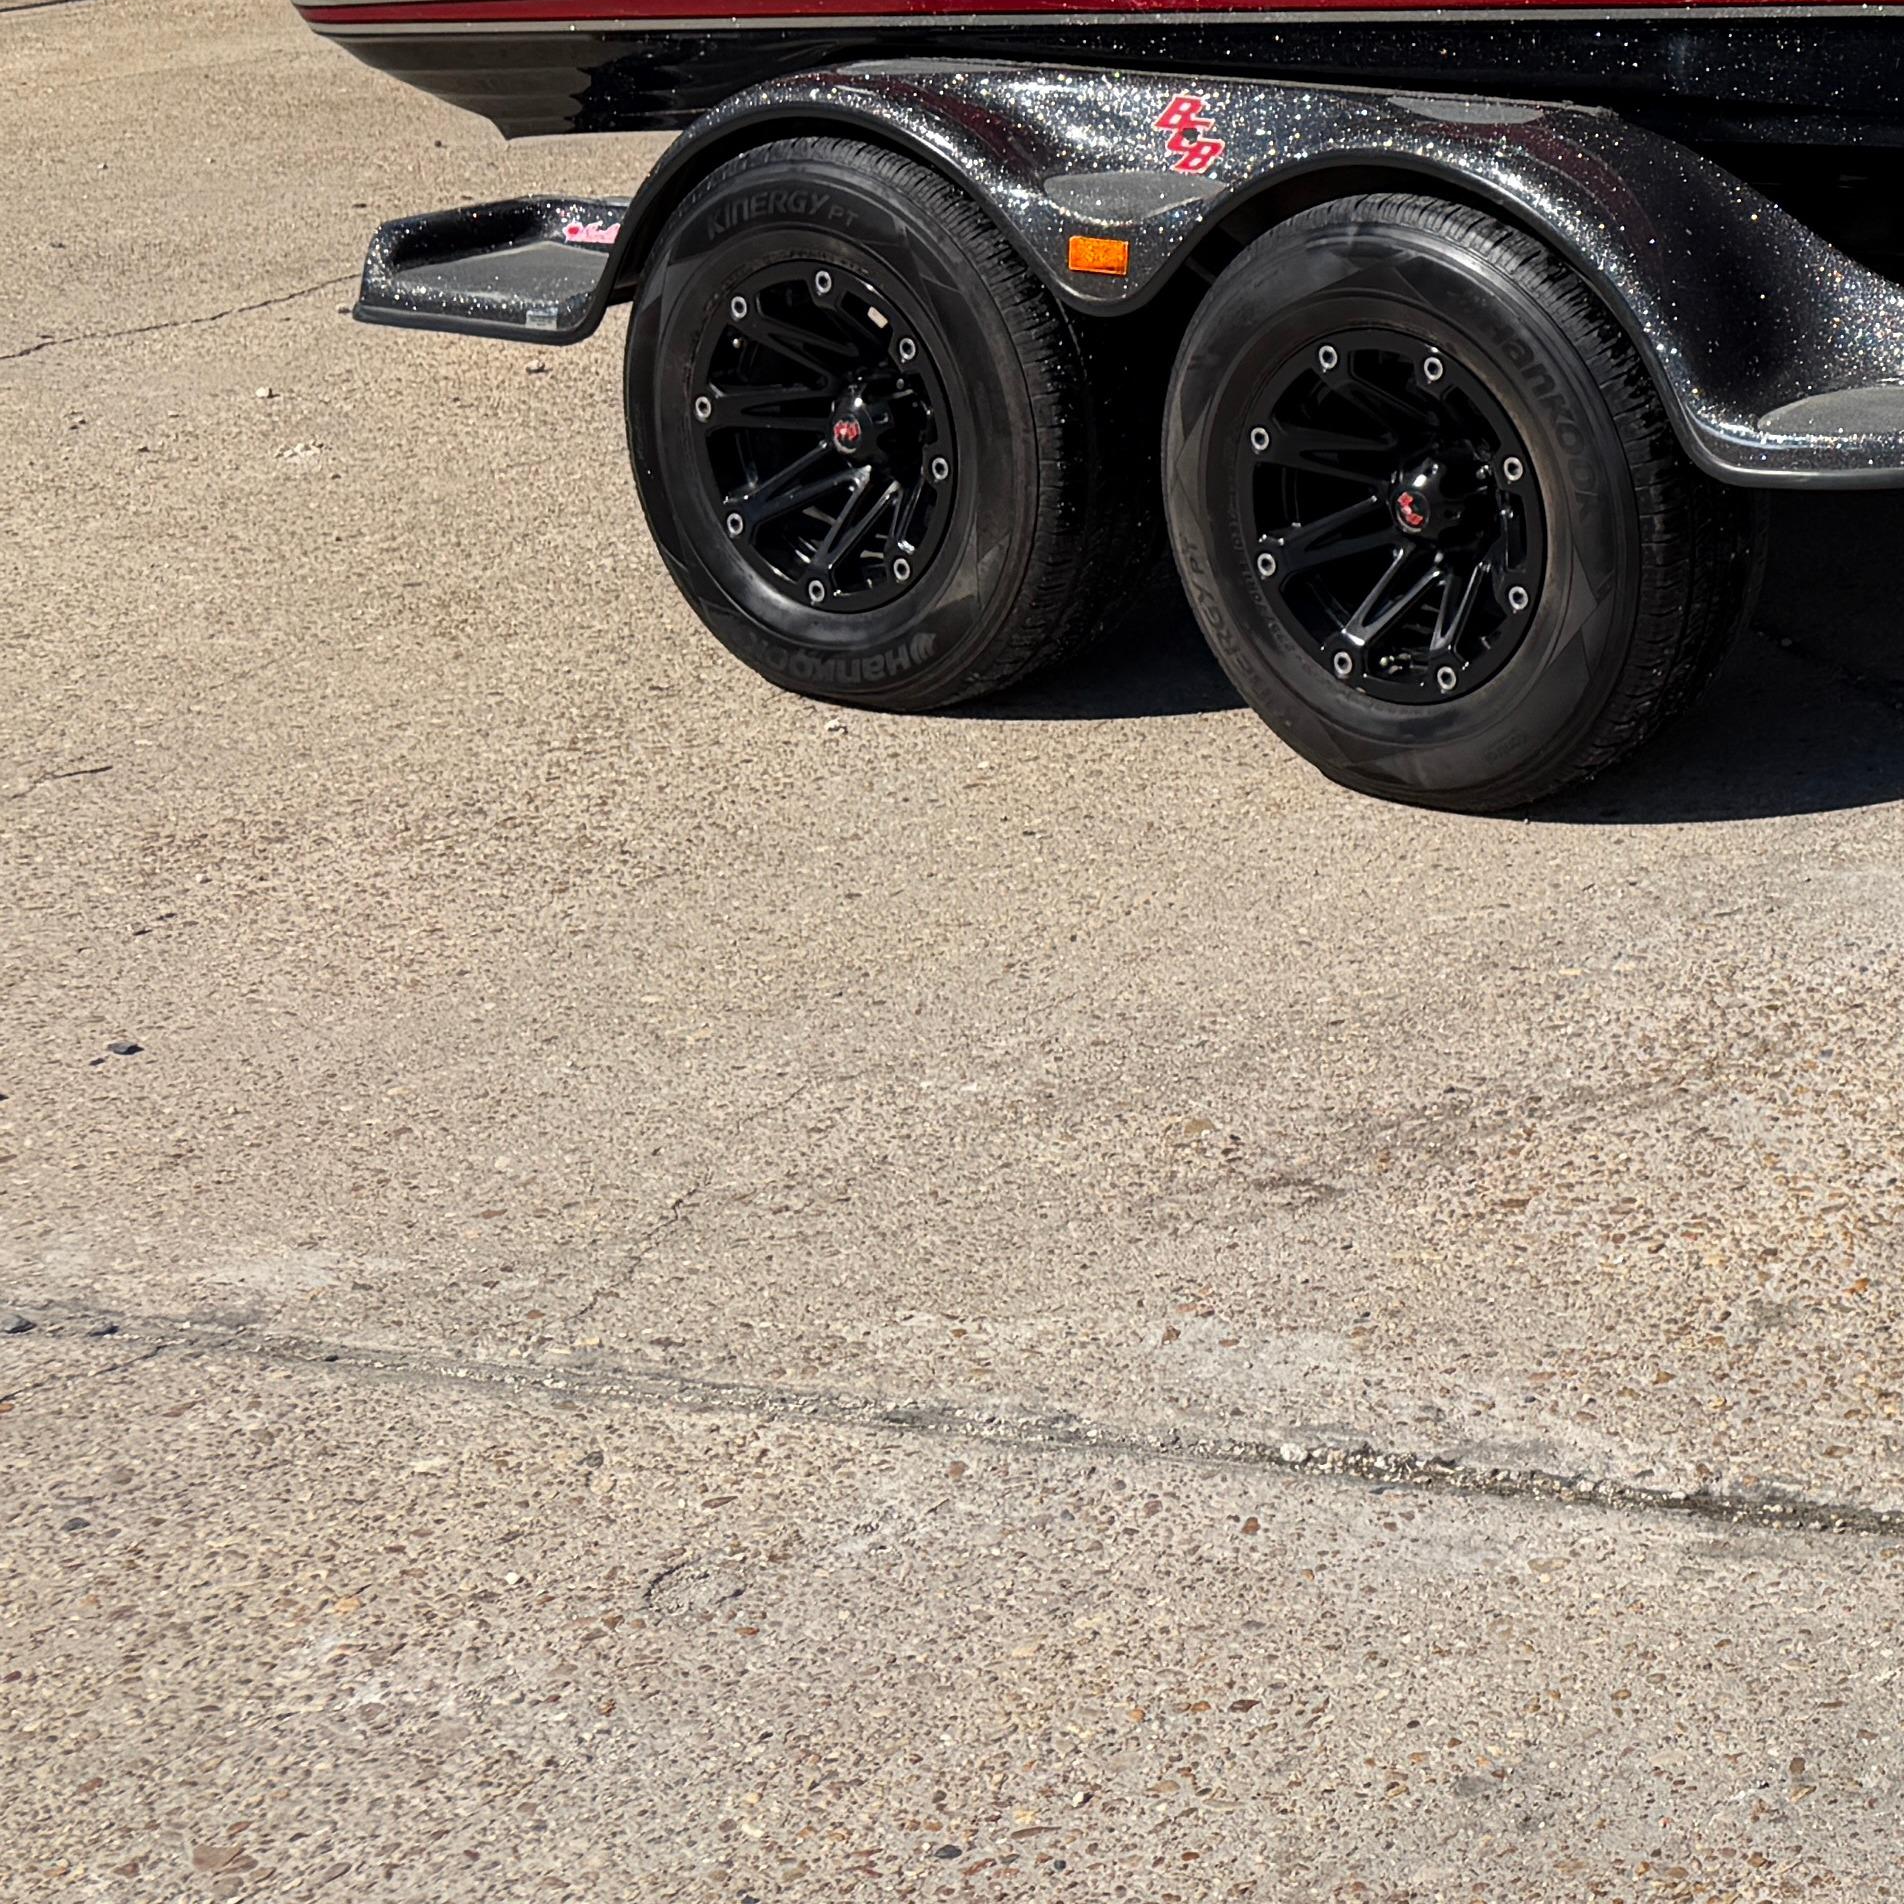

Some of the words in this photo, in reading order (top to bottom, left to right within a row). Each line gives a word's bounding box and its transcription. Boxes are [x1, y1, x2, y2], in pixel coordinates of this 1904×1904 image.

[1151, 94, 1226, 174] BCB
[707, 189, 830, 241] KINERGY
[828, 203, 860, 228] PT
